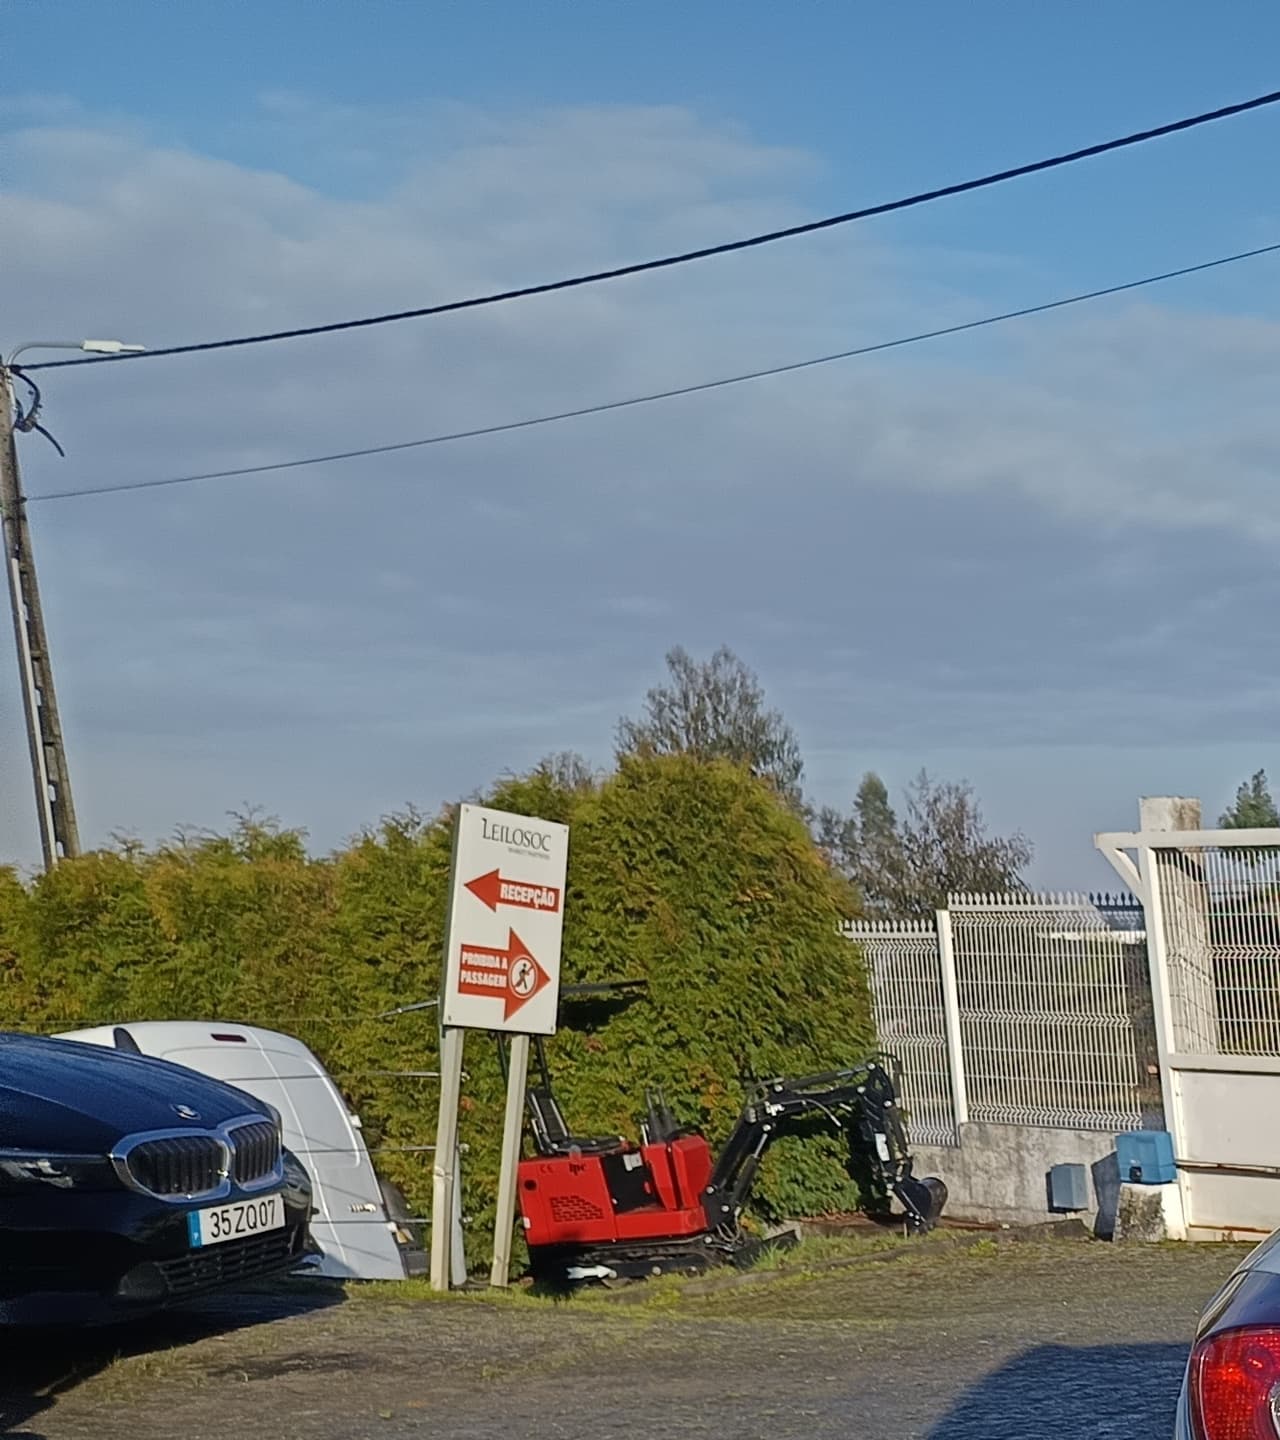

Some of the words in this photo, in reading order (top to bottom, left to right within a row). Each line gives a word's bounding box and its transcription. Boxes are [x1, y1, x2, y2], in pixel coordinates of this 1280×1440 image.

[482, 818, 551, 851] LEILOSOC
[500, 882, 555, 908] RECEPÇÃO
[462, 952, 500, 969] PROIBIDA
[501, 956, 508, 969] A
[461, 970, 507, 987] PASSAGEM
